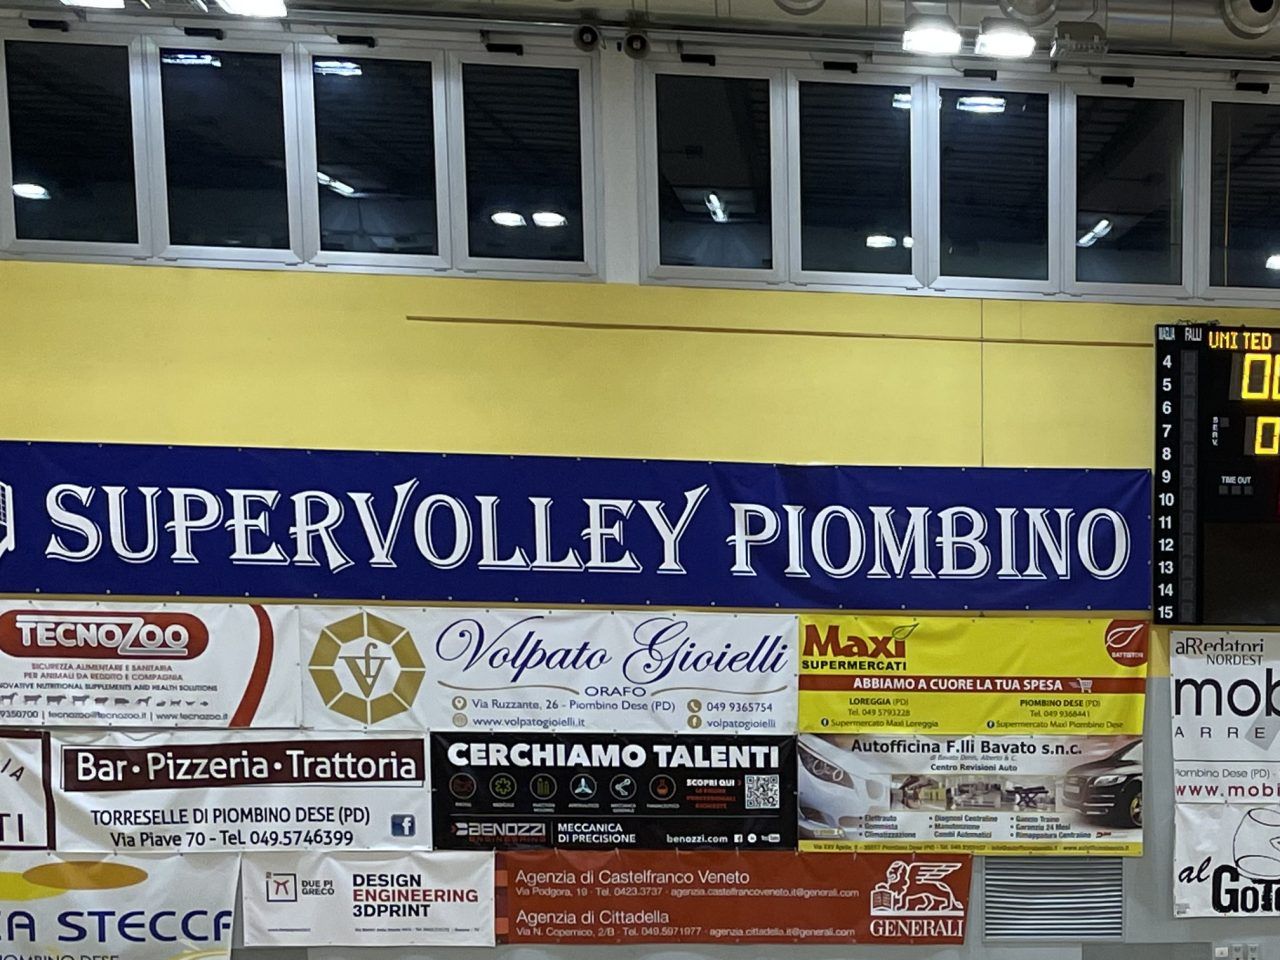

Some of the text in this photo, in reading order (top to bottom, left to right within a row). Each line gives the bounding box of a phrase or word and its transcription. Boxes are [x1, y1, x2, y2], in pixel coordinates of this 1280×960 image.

[1162, 378, 1172, 391] 5
[1162, 401, 1172, 414] 6
[1162, 425, 1172, 438] 7
[1255, 416, 1280, 455] 0
[1162, 447, 1172, 461] 8
[1162, 470, 1172, 483] 9
[1158, 493, 1174, 507] 10
[45, 478, 1131, 580] SUPERVOLLEY PIOMBINO
[1158, 516, 1172, 530] 11
[1158, 538, 1174, 552] 12
[1158, 561, 1174, 574] 13
[1158, 583, 1174, 597] 14
[1158, 606, 1173, 619] 15
[15, 614, 190, 657] TECNOZOO
[803, 623, 908, 659] Maxi
[435, 615, 788, 686] Volpato Gioielli
[802, 659, 907, 672] SUPERMERCATI
[1206, 654, 1264, 666] NORDEST
[853, 677, 1063, 691] ABBIAMO A CUORE LA TUA SPESA
[584, 686, 647, 697] ORAFO
[472, 699, 676, 713] Via Ruzzante, 26 Piombino Dese (PD)
[707, 702, 773, 713] 049 9365754
[849, 697, 891, 706] LOREGGIA
[1020, 699, 1062, 707] PIOMBINO
[472, 716, 586, 729] www.volpatogioielli.it
[707, 718, 776, 730] volpatogioielli
[851, 739, 940, 754] Autofficina
[980, 740, 1037, 754] Bavato
[1041, 743, 1082, 755] s.n.c.
[447, 742, 779, 769] CERCHIAMO TALENTI
[76, 749, 417, 782] Bar Pizzeria Trattoria
[930, 763, 1018, 772] Centro Revisioni Auto
[1222, 769, 1248, 778] Dese
[1250, 768, 1270, 780] (PD)
[686, 779, 735, 787] SCOPRI QUI
[90, 806, 370, 826] TORRESELLE DI PIOMBINO DESE (PD)
[468, 822, 546, 836] BENOZZI
[558, 823, 623, 833] MECCANICA
[110, 829, 354, 847] Via Piave 70 049.5746399
[558, 833, 570, 843] DI
[572, 834, 636, 843] PRECISIONE
[666, 834, 728, 843] benozzi.com
[1178, 856, 1213, 883] al
[301, 880, 333, 888] DUE PI
[352, 874, 422, 887] DESIGN
[515, 869, 750, 886] Agenzia di Castelfranco Veneto
[301, 887, 335, 896] GRECO
[352, 889, 479, 903] ENGINEERING
[515, 887, 530, 896] Via
[532, 887, 573, 898] Podgora,
[596, 887, 612, 896] Tel.
[614, 887, 663, 896] 0423.3737
[352, 904, 431, 917] 3DPRINT
[515, 909, 670, 926] Agenzia di Cittadella
[516, 927, 531, 936] Via
[598, 927, 615, 936] 2/B
[623, 927, 639, 936] Tel.
[641, 927, 702, 936] 049.5971977
[869, 919, 965, 937] GENERALI
